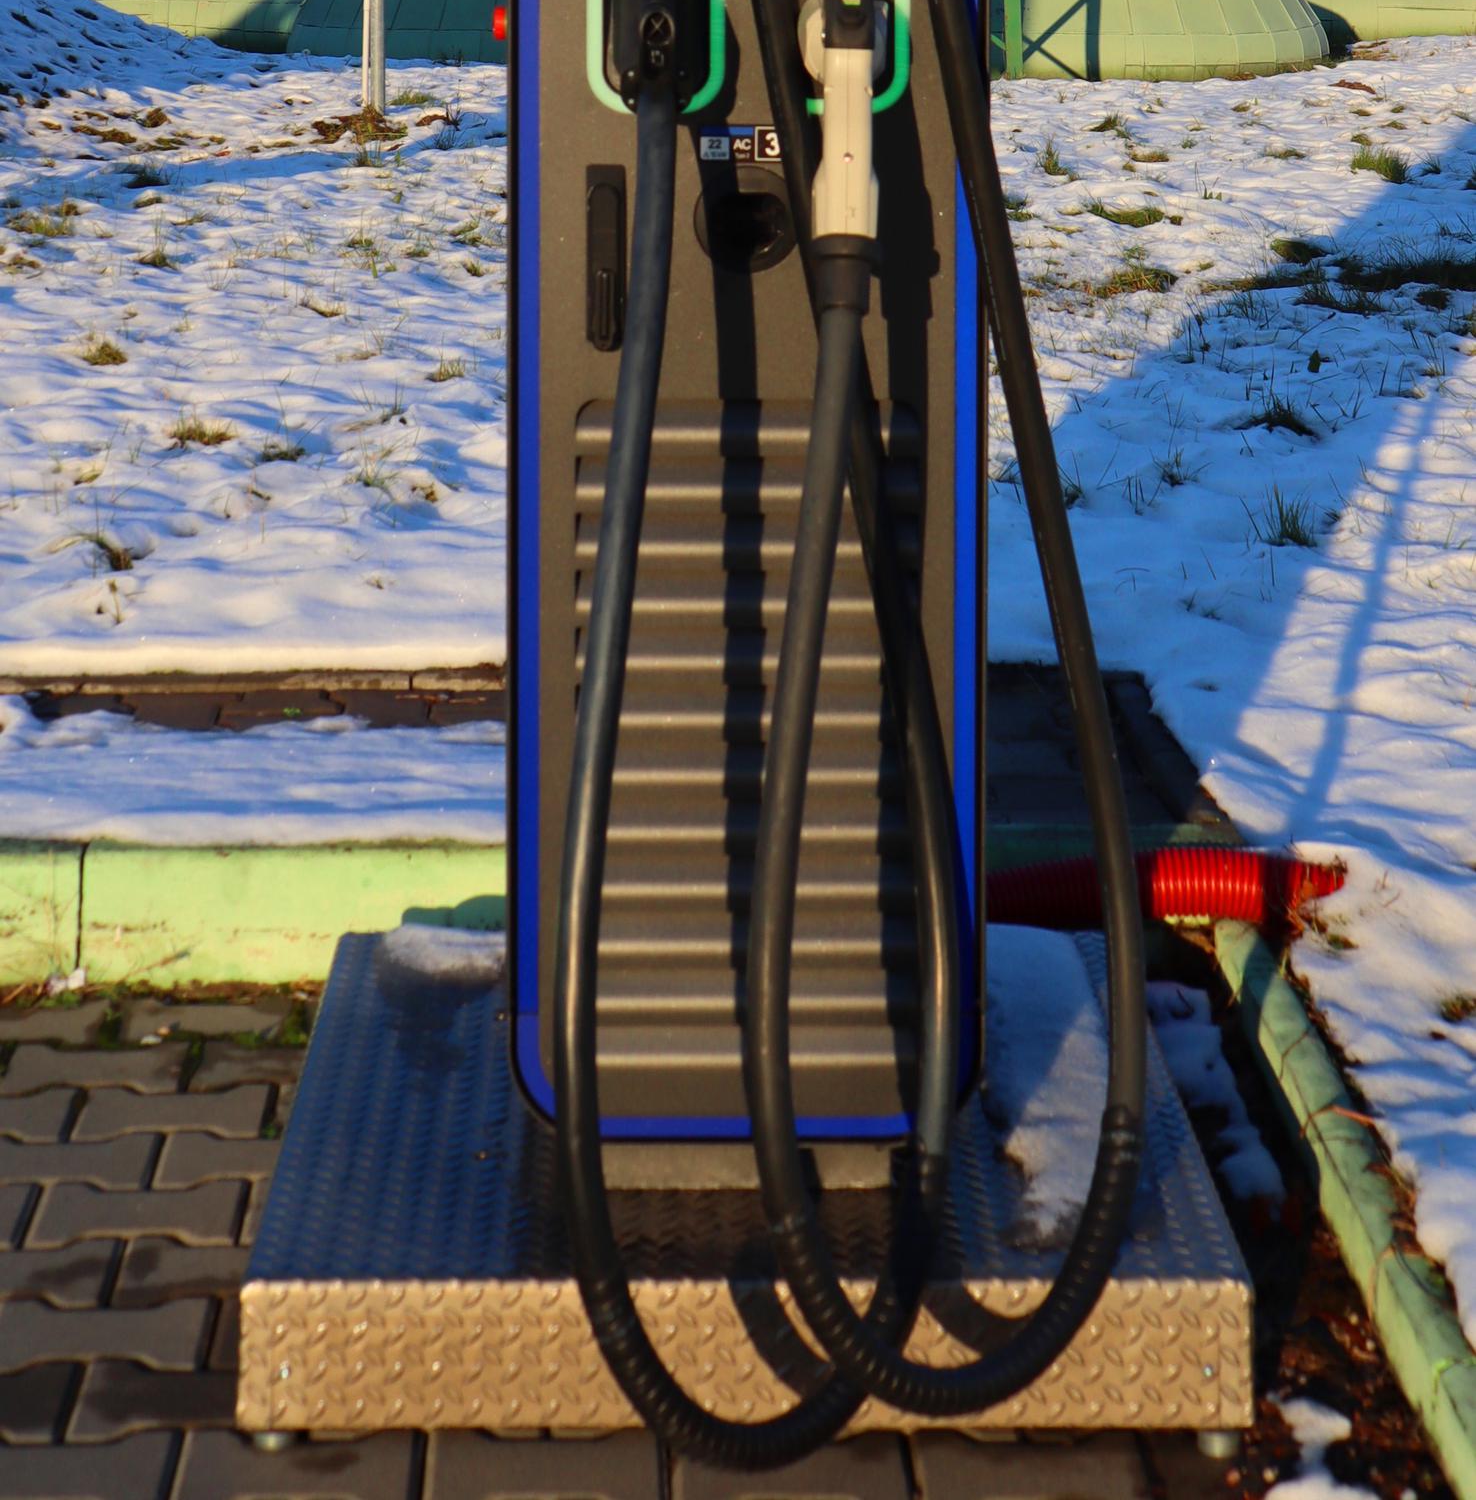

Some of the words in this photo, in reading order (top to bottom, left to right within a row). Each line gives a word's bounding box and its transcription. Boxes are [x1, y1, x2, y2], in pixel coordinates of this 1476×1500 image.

[708, 139, 722, 149] 22
[733, 138, 752, 150] AC
[764, 132, 780, 156] 3
